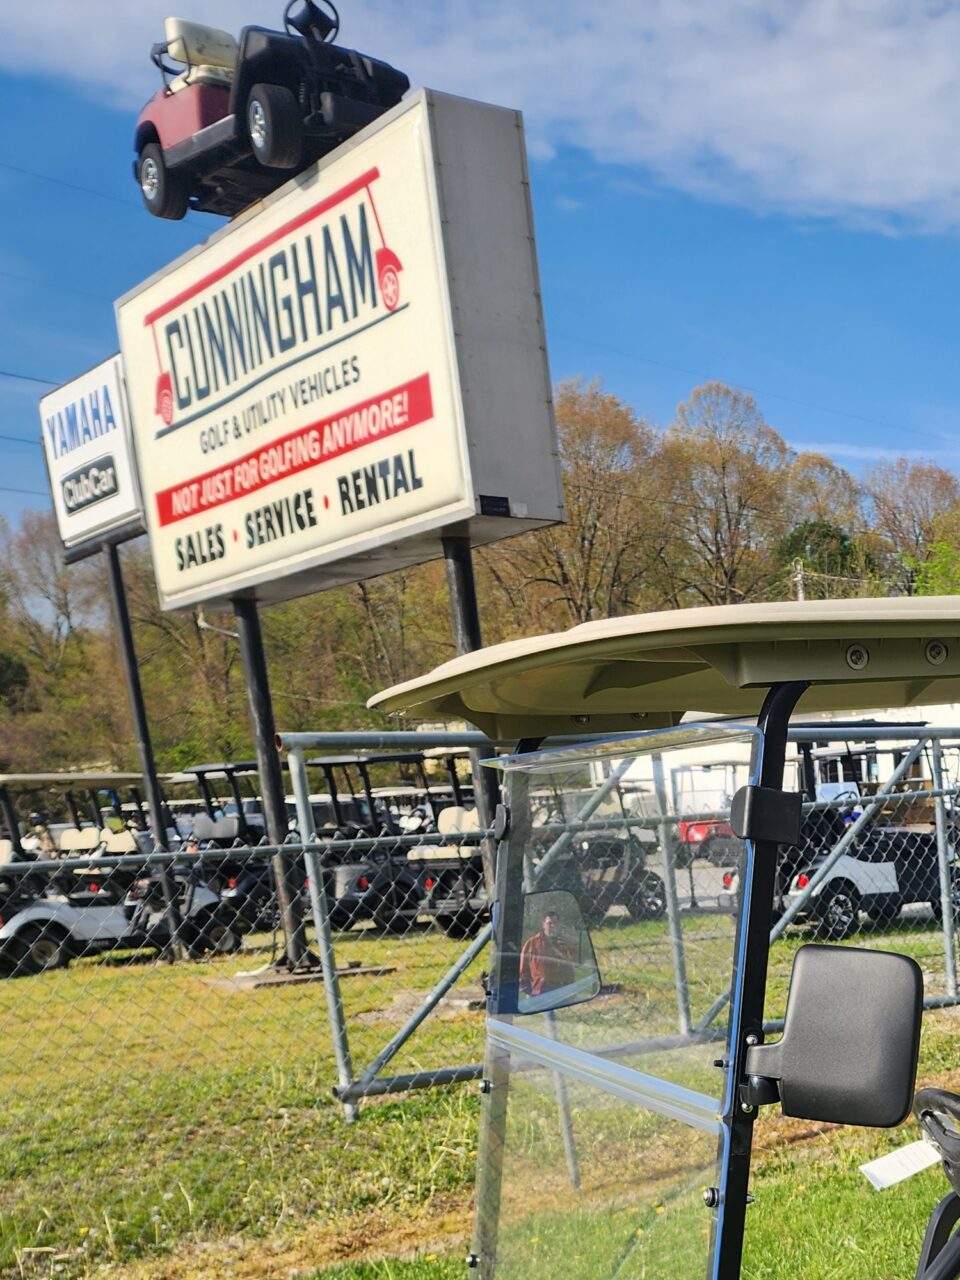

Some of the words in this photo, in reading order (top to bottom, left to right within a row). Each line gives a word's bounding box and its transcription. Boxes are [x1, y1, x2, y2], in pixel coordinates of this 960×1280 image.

[165, 202, 378, 411] CUNNINGHAM
[46, 384, 117, 460] YAMAHA
[170, 486, 200, 516] NOT
[200, 470, 235, 505] JUST
[234, 459, 259, 492] FOR
[258, 430, 321, 480] GOLFING
[323, 391, 409, 455] ANYMORE!
[200, 423, 230, 454] GOLF
[232, 415, 242, 439] &
[242, 387, 287, 433] UTILITY
[290, 355, 361, 411] VEHICLES
[174, 524, 226, 571] SALES
[244, 488, 318, 549] SERVICE
[336, 448, 424, 516] RENTAL
